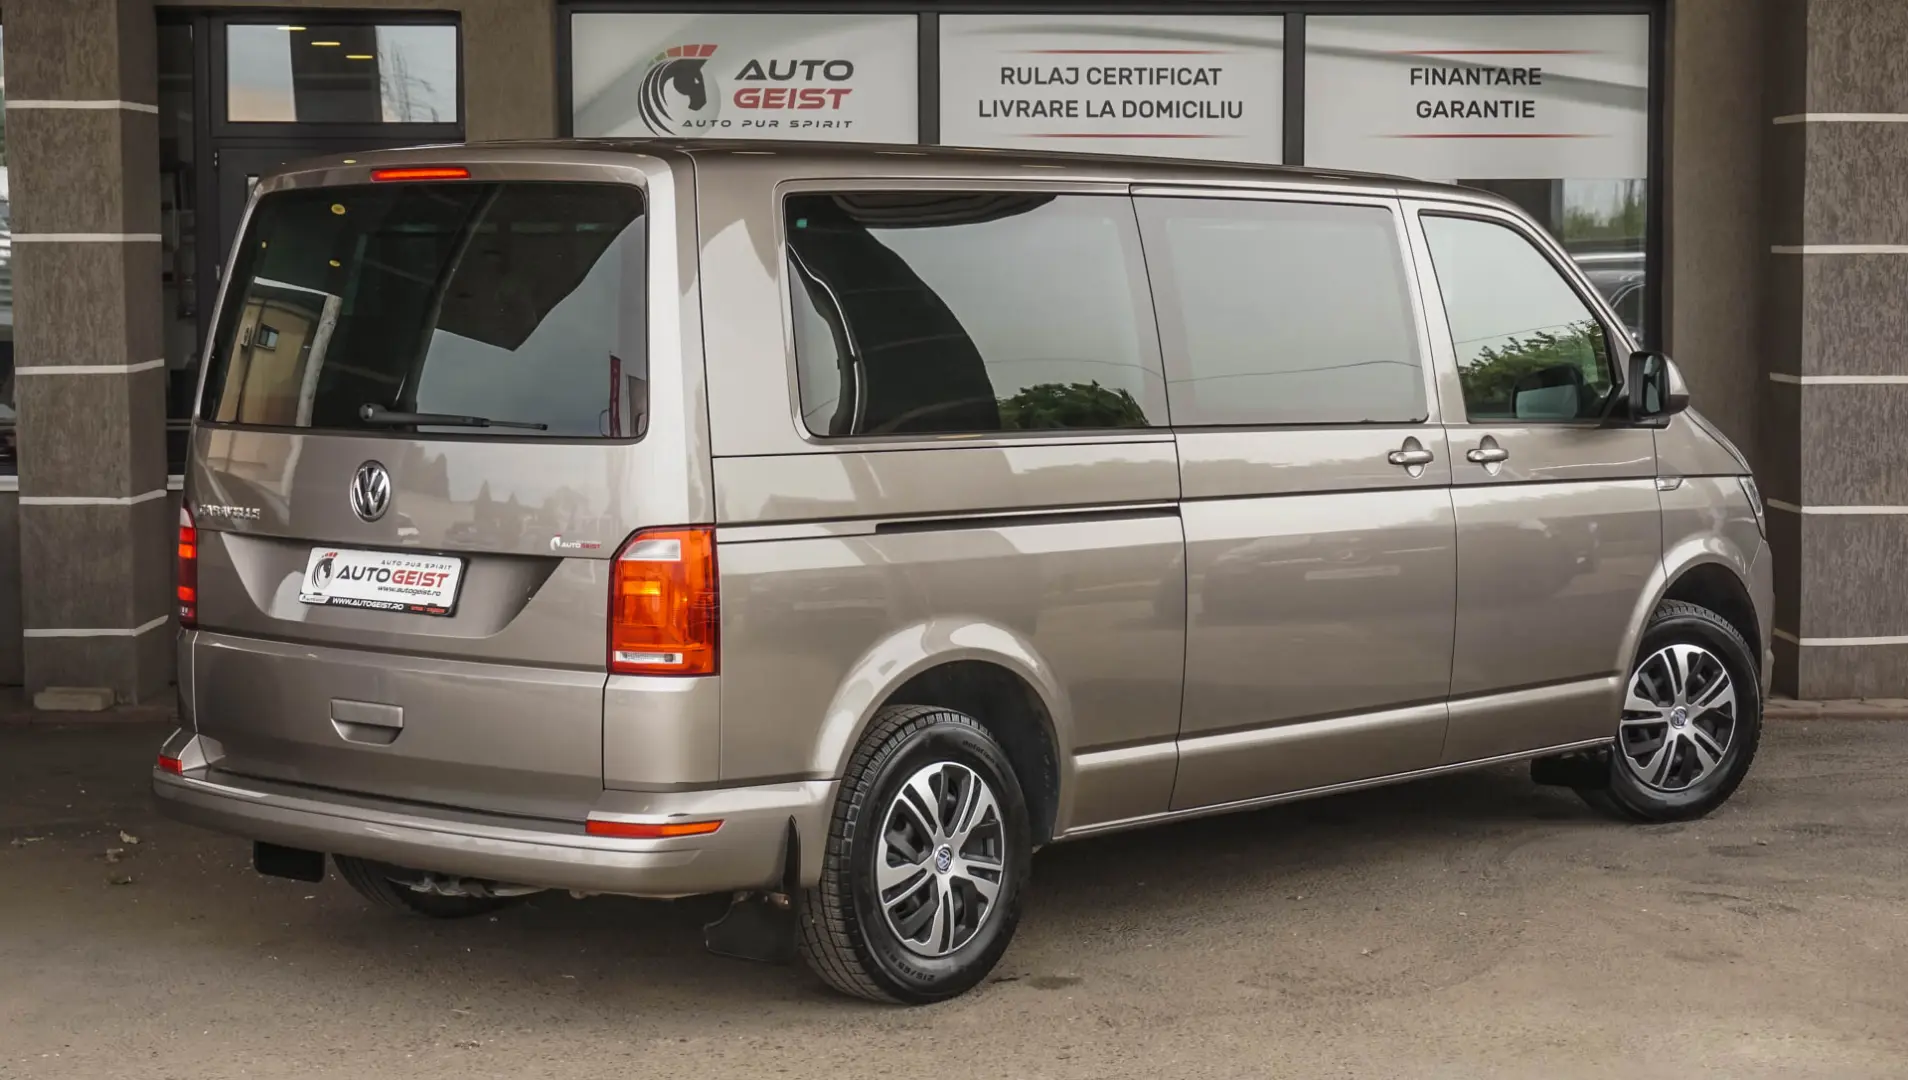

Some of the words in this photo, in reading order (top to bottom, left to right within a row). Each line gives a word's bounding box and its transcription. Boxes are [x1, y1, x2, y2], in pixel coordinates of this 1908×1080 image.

[734, 59, 855, 81] AUTO
[1000, 66, 1080, 85] RULAJ
[1086, 67, 1222, 86] CERTIFICAT
[1410, 67, 1542, 86] FINANTARE
[733, 88, 853, 110] GEIST
[978, 99, 1079, 118] LIVRARE
[1085, 100, 1116, 118] LA
[1122, 100, 1243, 119] DOMICILIU
[1416, 100, 1535, 119] GARANTIE
[682, 119, 732, 128] AUTO
[741, 119, 780, 129] PUR
[789, 120, 853, 129] SPIRIT
[377, 586, 442, 597] www.autogeist.ro
[332, 597, 404, 611] WWW.AUTOGEIST.RO
